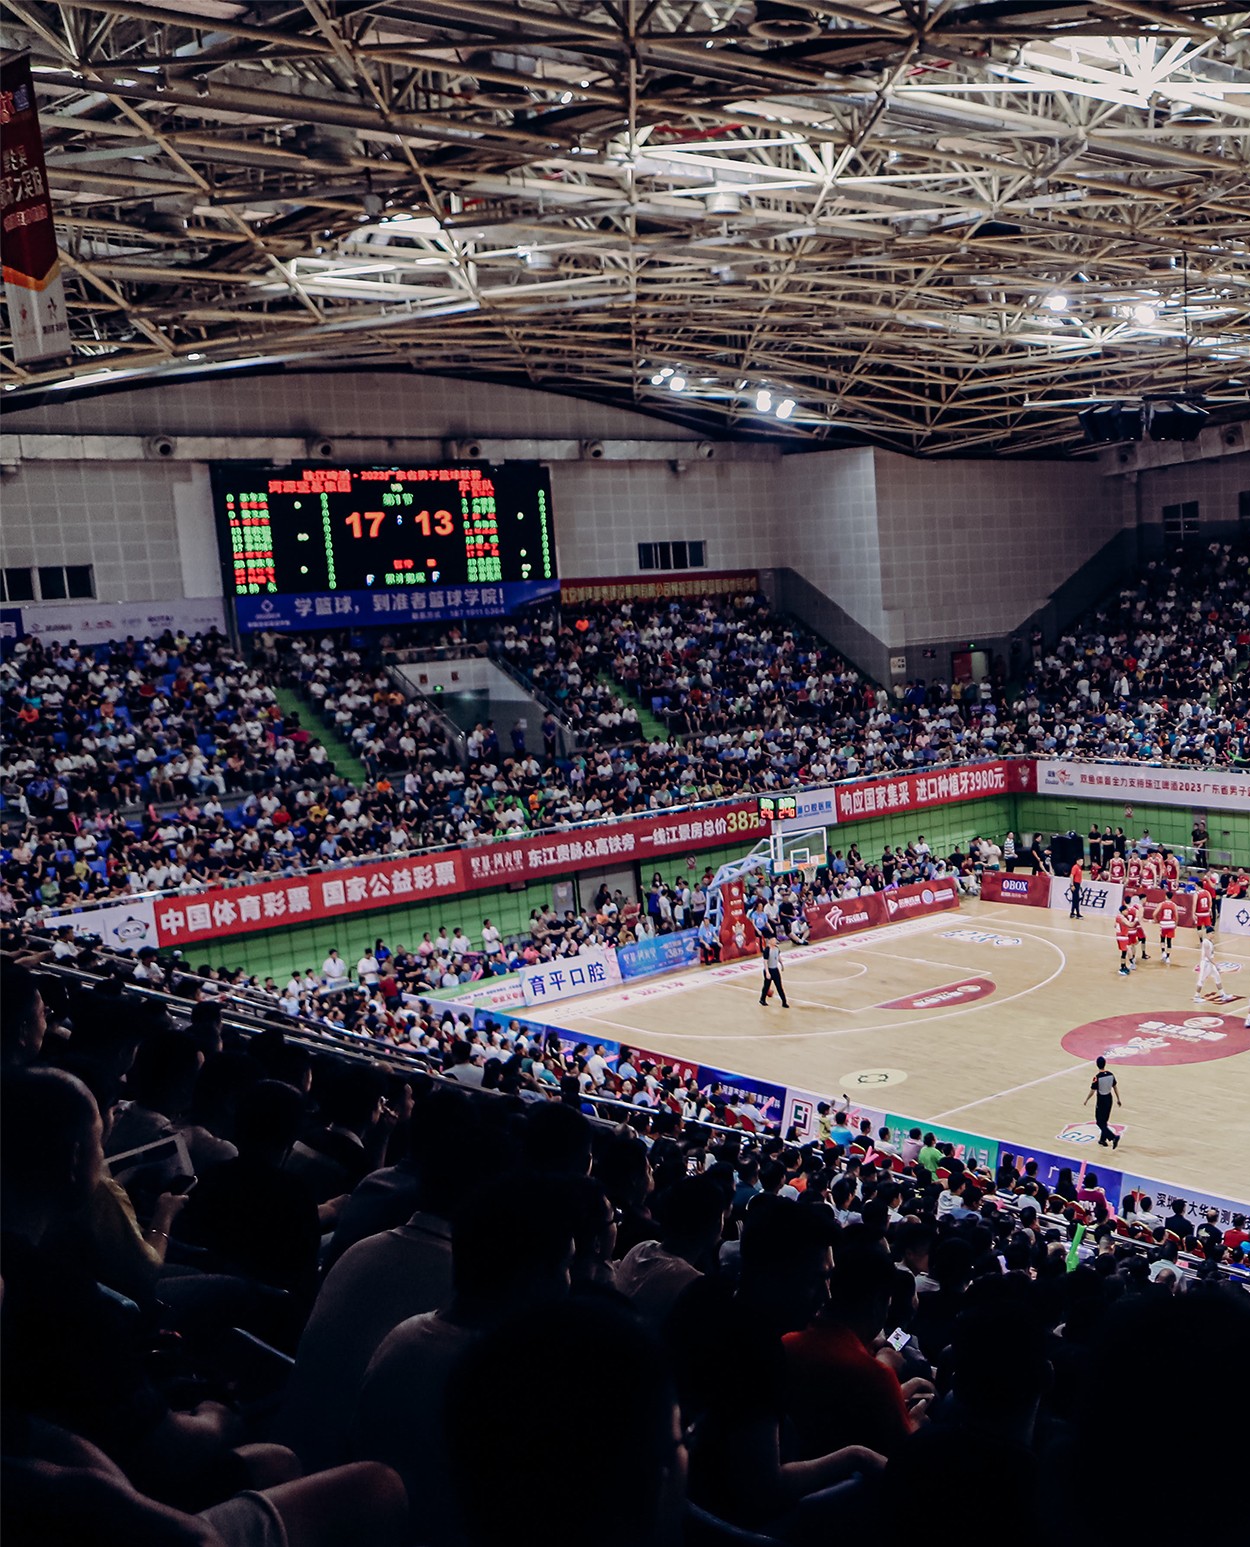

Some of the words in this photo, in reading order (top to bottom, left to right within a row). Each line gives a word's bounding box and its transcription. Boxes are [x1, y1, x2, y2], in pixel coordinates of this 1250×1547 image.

[344, 511, 386, 539] 17
[414, 509, 455, 537] 13
[840, 780, 910, 816] 响应国家集采
[915, 767, 1006, 802] 进口种植牙3980元
[160, 884, 312, 936] 中国体育彩票
[321, 860, 456, 906] 国家公益彩票
[1002, 879, 1028, 892] OBOX
[528, 961, 606, 997] 育平口腔
